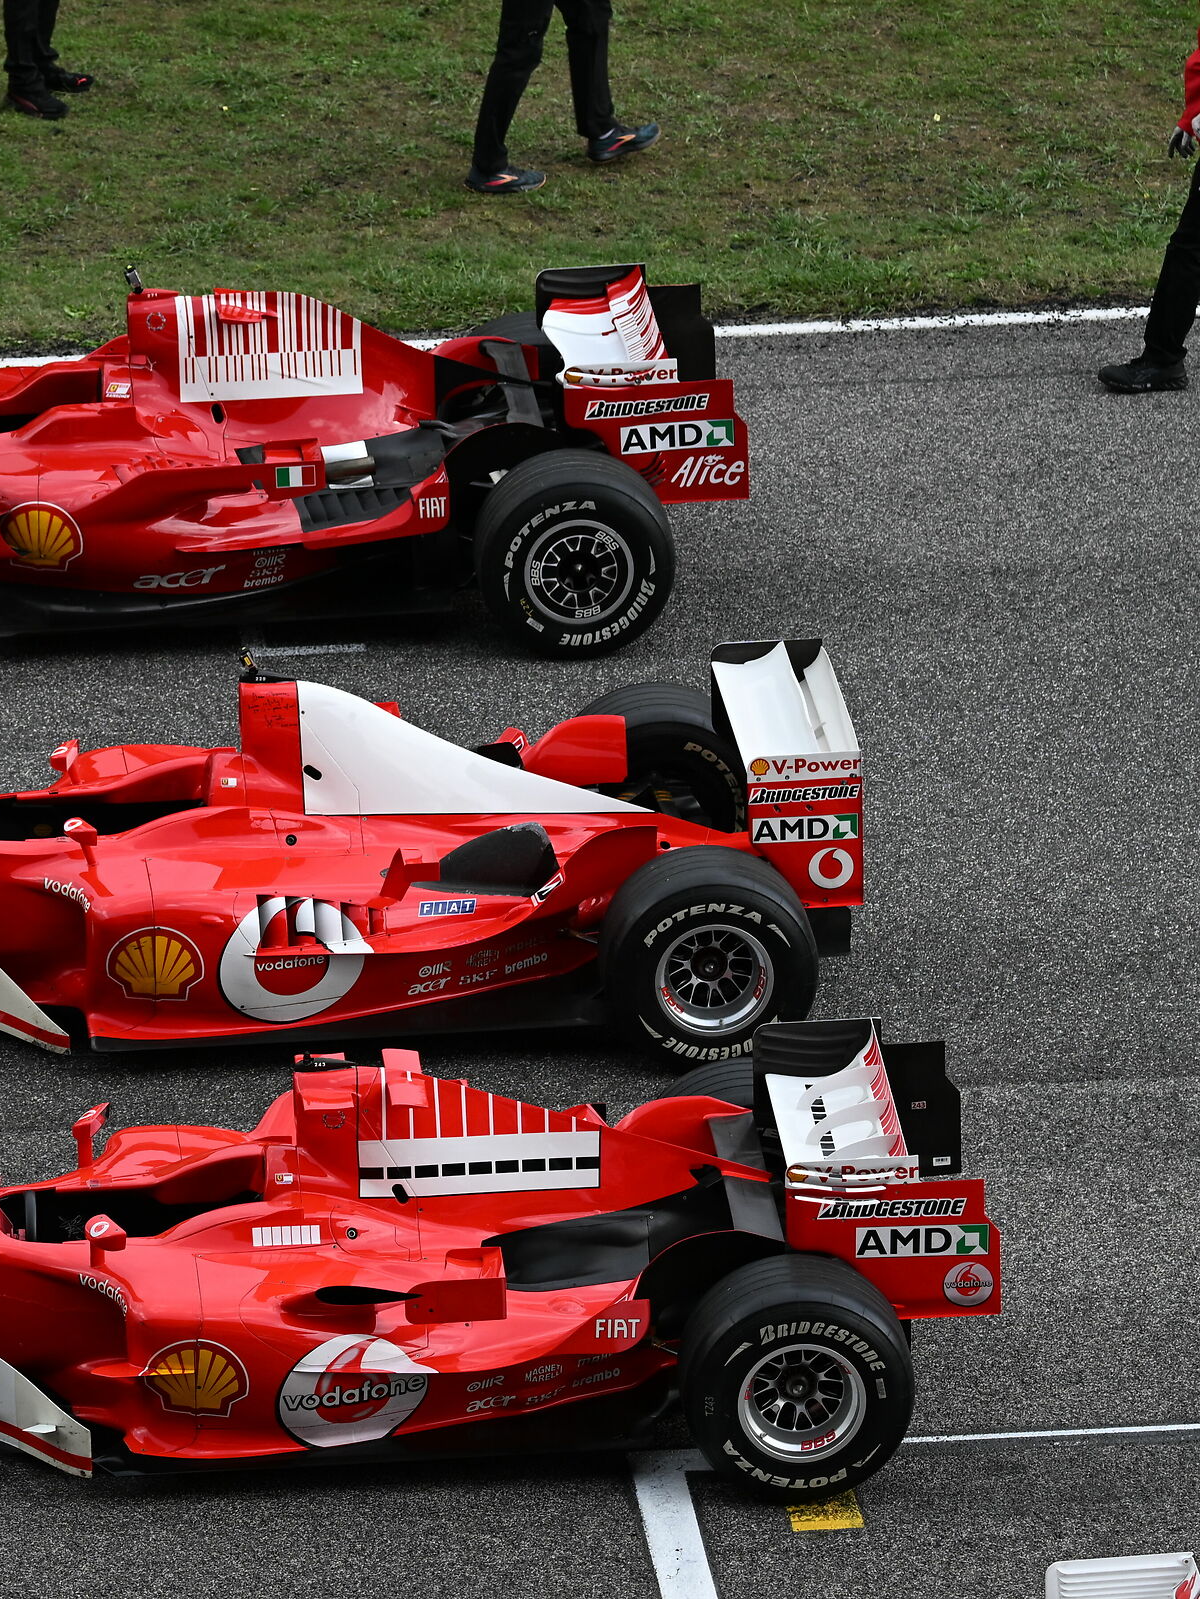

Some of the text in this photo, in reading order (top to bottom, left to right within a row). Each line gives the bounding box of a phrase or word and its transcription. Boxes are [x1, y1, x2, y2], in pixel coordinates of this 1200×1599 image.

[585, 394, 709, 420] BRIDGESTONE
[622, 424, 703, 452] AMD
[671, 454, 745, 487] Alice
[419, 497, 446, 518] FIAT
[504, 500, 597, 568] POTENZA
[595, 531, 619, 551] BBS
[133, 565, 225, 588] acer
[244, 575, 284, 588] brembo
[531, 560, 541, 586] BBS
[559, 578, 656, 646] BRIDGESTONE
[575, 605, 601, 618] BBS
[771, 757, 861, 775] V-Power
[748, 783, 860, 805] BRIDGESTONE
[753, 817, 830, 842] AMD
[44, 877, 91, 913] vodafone
[423, 901, 475, 914] FIAT
[643, 903, 762, 948] POTENZA
[256, 955, 325, 972] vodafone
[505, 952, 548, 975] brembo
[407, 977, 451, 996] acer
[661, 1037, 753, 1061] DGESTONE
[817, 1197, 968, 1220] BRIDGESTONE
[856, 1227, 952, 1255] AMD
[79, 1273, 128, 1317] vodafone
[595, 1319, 641, 1338] FIAT
[759, 1321, 886, 1372] BRIDGESTONE
[283, 1374, 426, 1411] vodafone
[466, 1395, 516, 1413] acer
[723, 1439, 848, 1489] POTENZA
